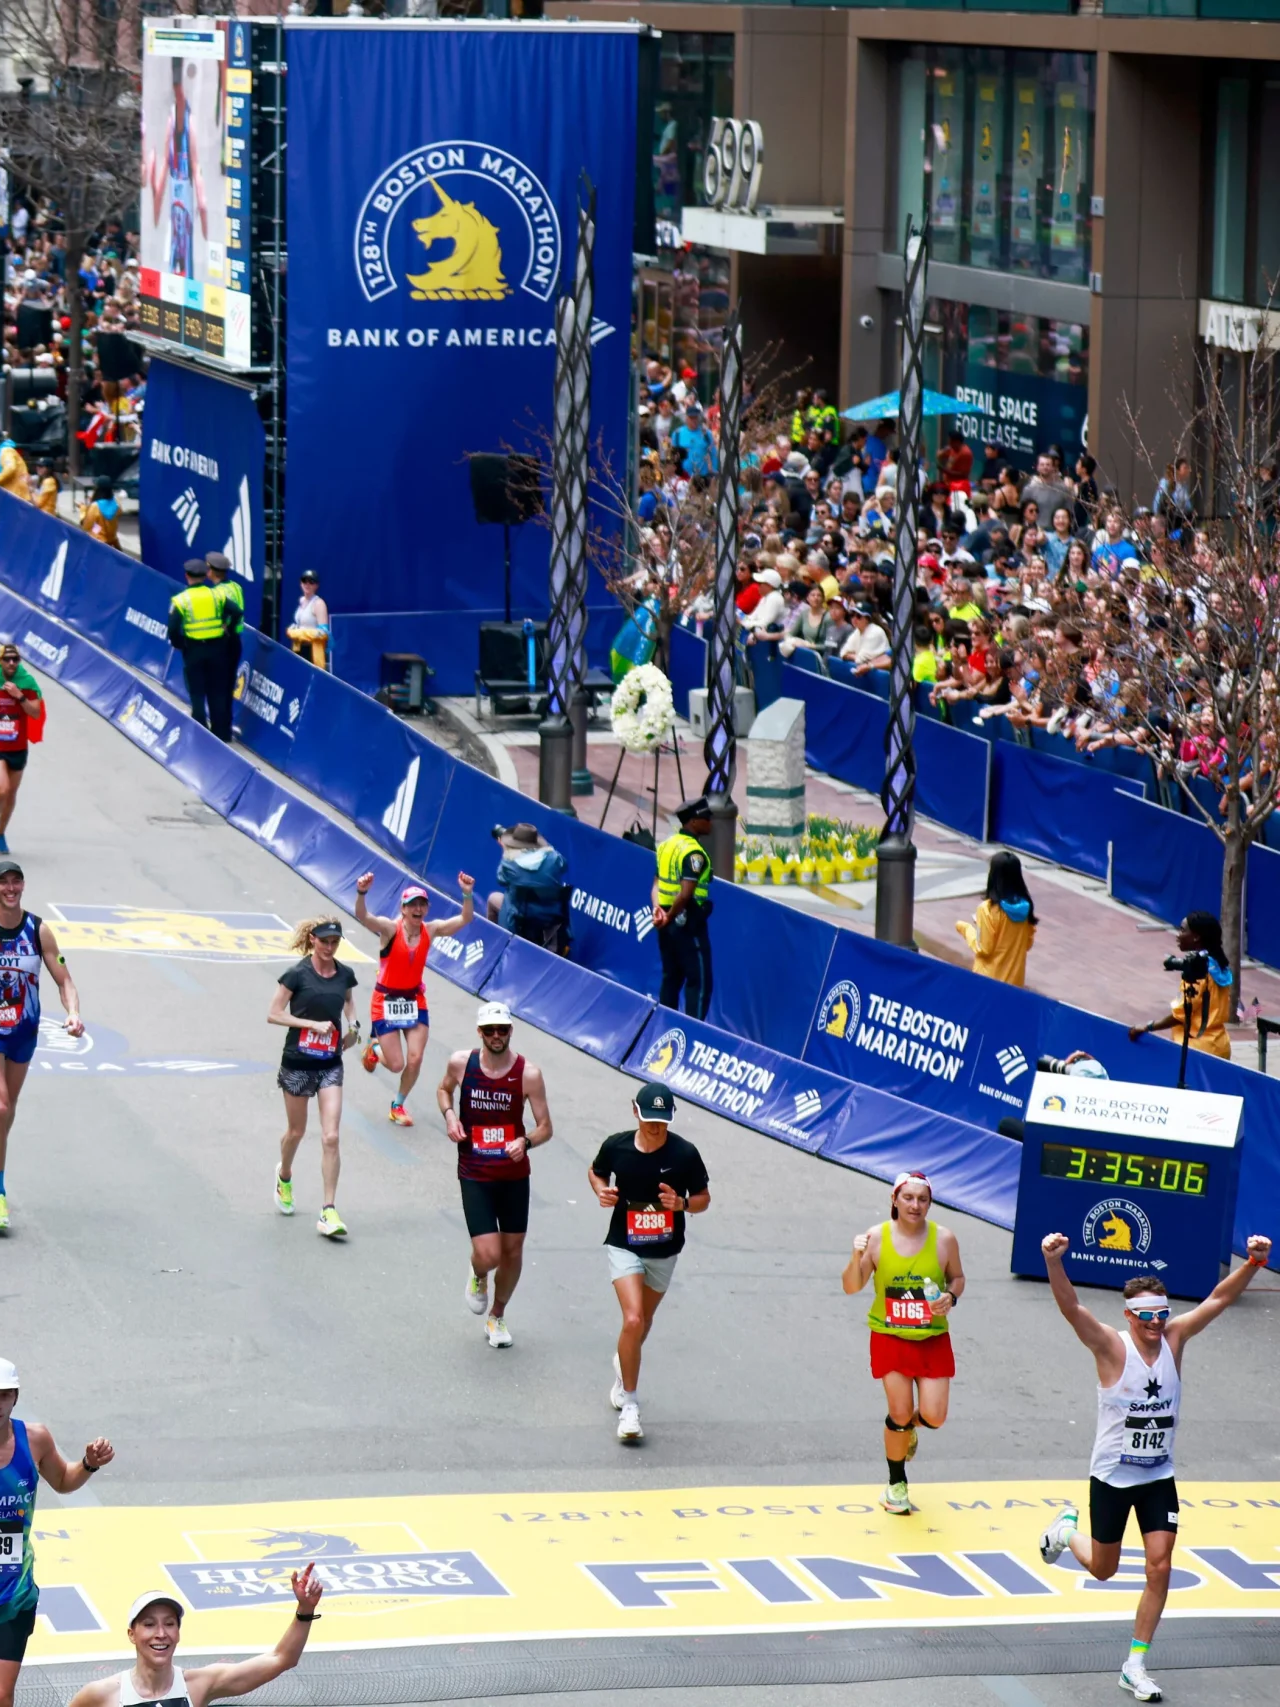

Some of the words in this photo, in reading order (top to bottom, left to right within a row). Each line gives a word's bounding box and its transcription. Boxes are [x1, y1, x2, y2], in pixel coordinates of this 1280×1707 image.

[373, 149, 465, 213] BOSTON
[704, 116, 764, 215] 699
[480, 153, 555, 285] MARATHON
[363, 221, 386, 289] 128TH
[328, 329, 399, 346] BANK
[407, 329, 439, 346] OF
[446, 329, 557, 346] AMERICA
[999, 395, 1037, 426] SPACE
[956, 414, 978, 440] FOR
[980, 419, 1019, 450] LEASE
[151, 438, 171, 465] BANK
[173, 446, 190, 468] OF
[189, 450, 219, 482] AMERICA
[571, 888, 588, 910] OF
[584, 895, 631, 934] AMERICA
[867, 993, 902, 1028] THE
[898, 1005, 969, 1052] BOSTON
[687, 1040, 720, 1070] THE
[714, 1051, 775, 1094] BOSTON
[856, 1022, 964, 1083] MARATHON
[471, 1089, 491, 1100] MILL
[493, 1092, 512, 1103] CITY
[471, 1100, 510, 1111] RUNNING
[671, 1065, 763, 1118] MARATHON
[978, 1083, 993, 1096] BANK
[1109, 1099, 1170, 1115] BOSTON
[1074, 1106, 1168, 1125] MARATHON
[482, 1128, 504, 1143] 680
[1066, 1147, 1206, 1193] 3:35:06
[1085, 1222, 1093, 1240] THE
[1090, 1201, 1121, 1220] BOSTON
[1125, 1203, 1149, 1247] MARATHON
[1071, 1252, 1095, 1262] BANK
[1096, 1255, 1108, 1264] OF
[1109, 1257, 1149, 1269] AMERICA
[1129, 1399, 1173, 1412] SAYSKY
[1131, 1431, 1166, 1449] 8142
[493, 1510, 643, 1523] 128TH
[671, 1502, 920, 1519] BOSTO
